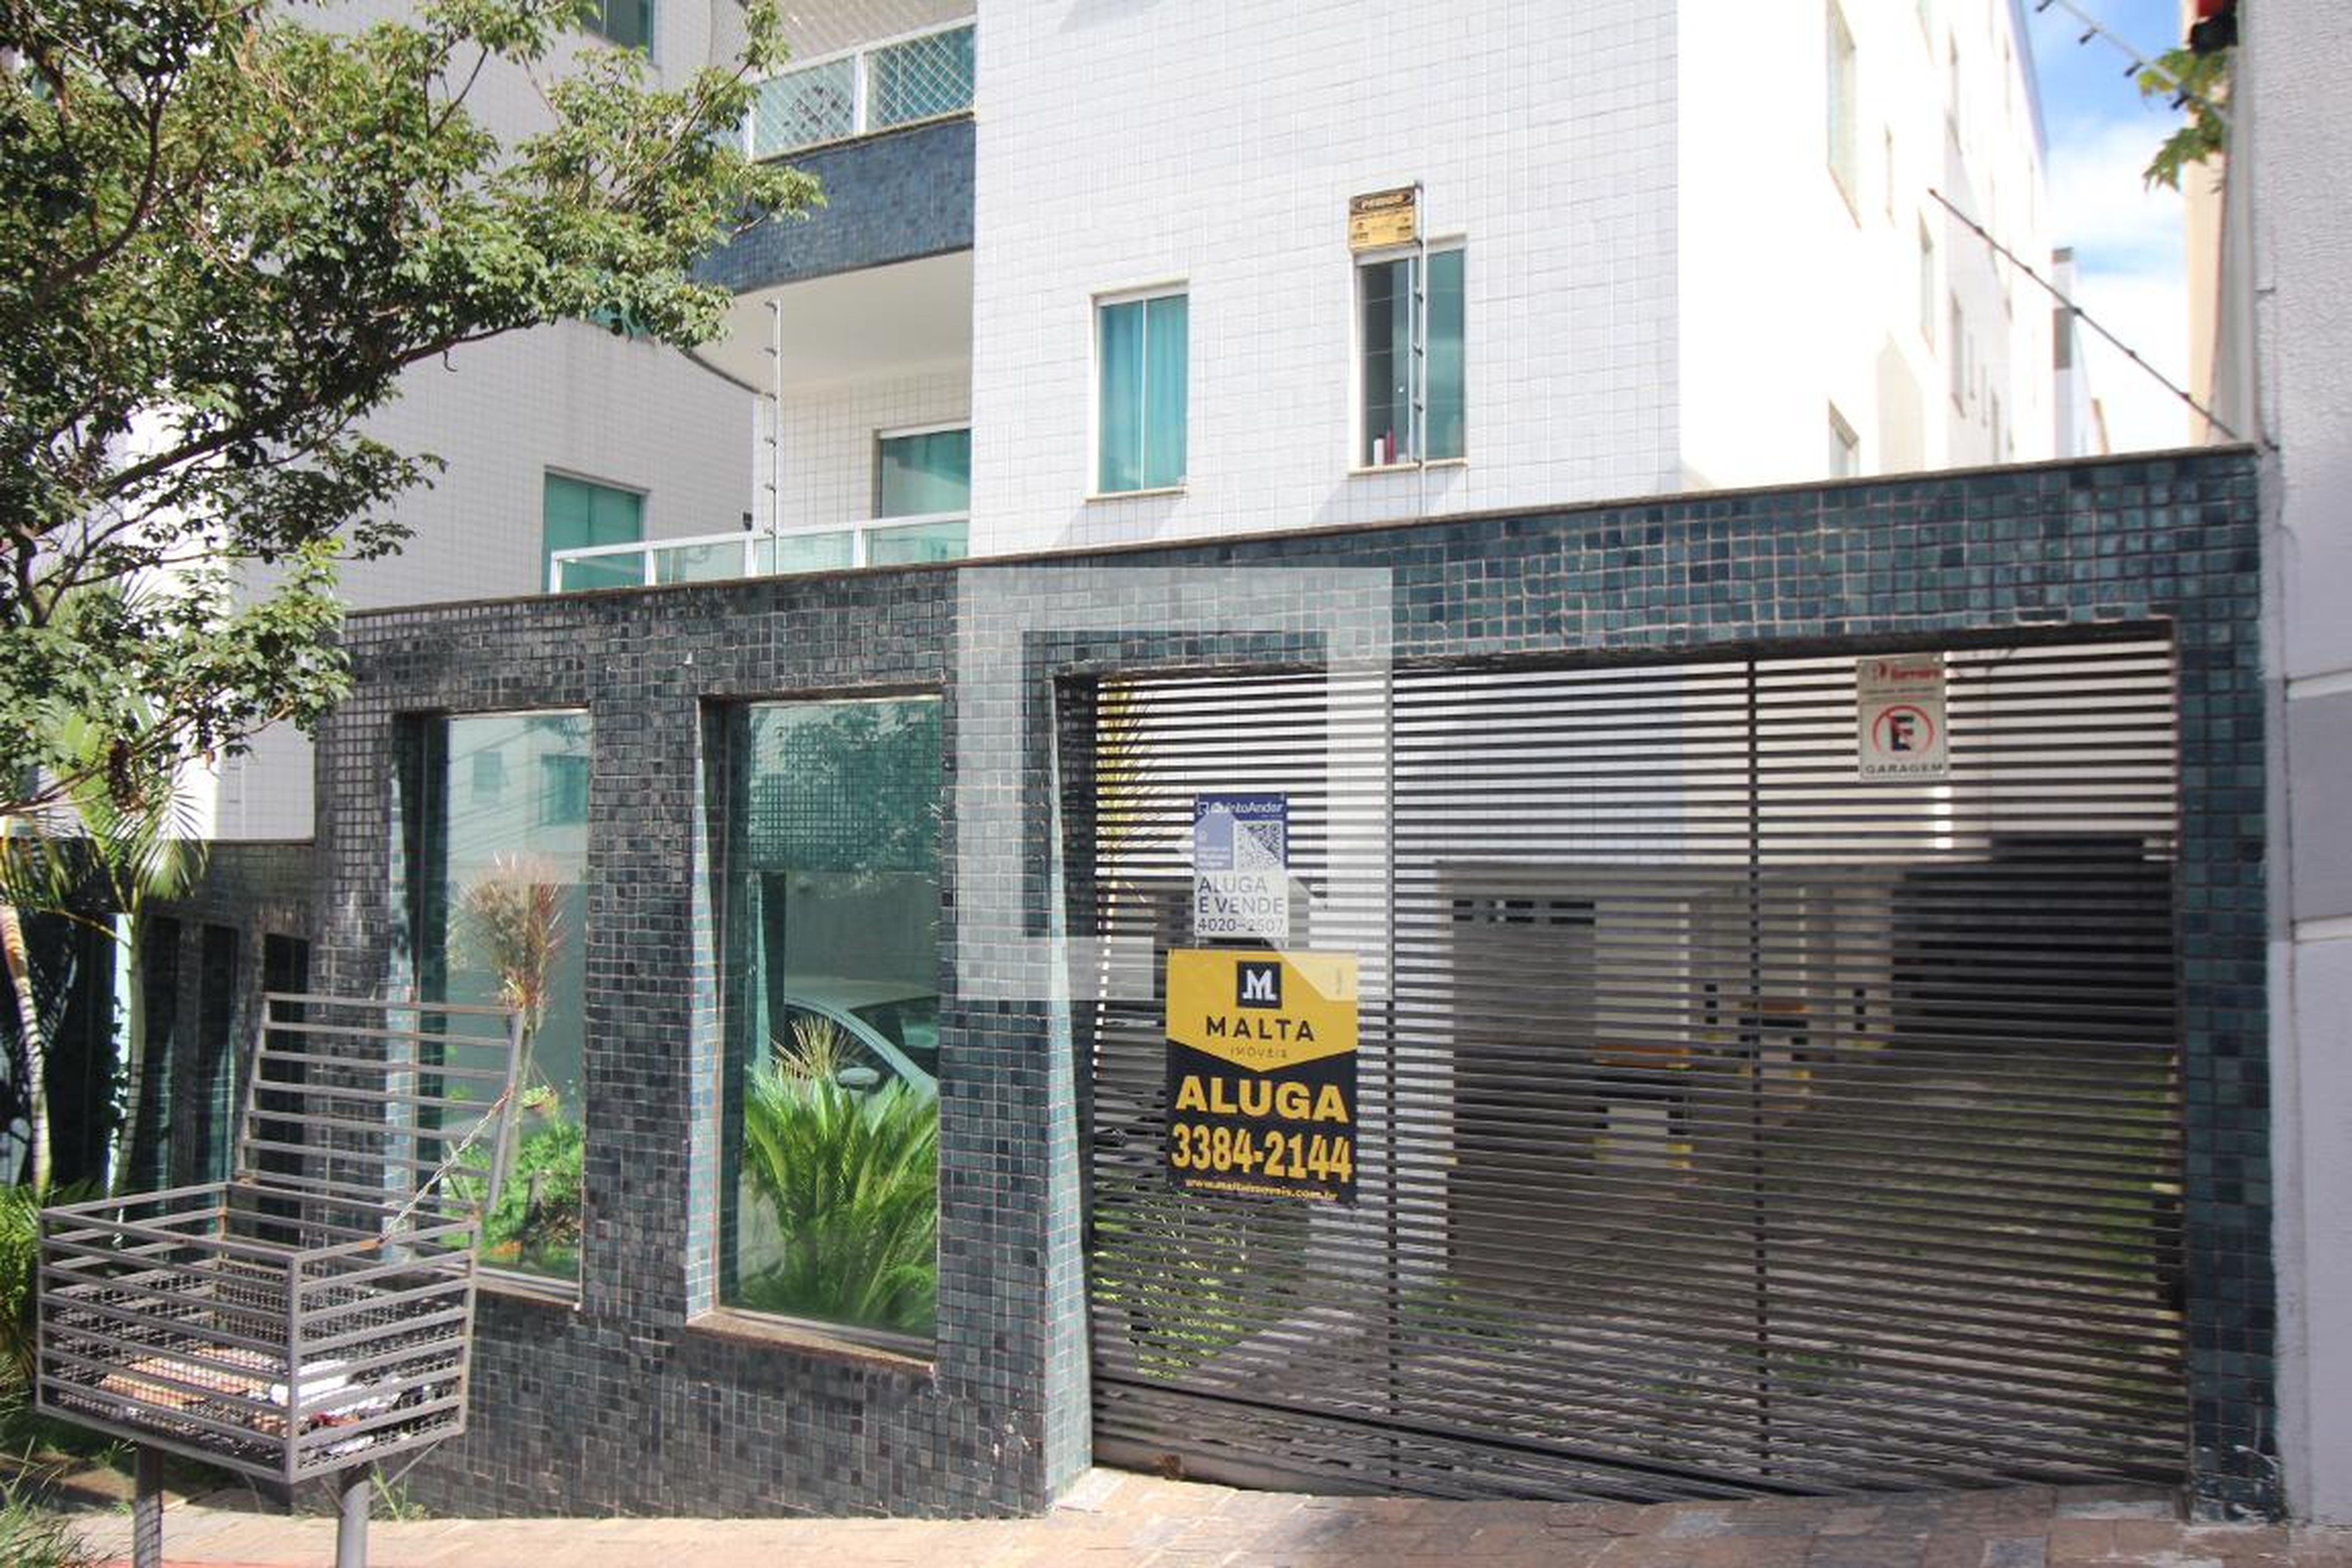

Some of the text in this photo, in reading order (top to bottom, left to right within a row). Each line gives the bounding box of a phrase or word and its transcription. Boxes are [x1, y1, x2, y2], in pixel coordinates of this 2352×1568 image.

[1865, 763, 1943, 774] GARAGEM
[1197, 875, 1268, 893] ALUGA
[1199, 897, 1284, 914] E VENDE
[1205, 1015, 1315, 1042] MALTA
[1175, 1074, 1349, 1122] ALUGA
[1172, 1123, 1352, 1183] 3384-2144
